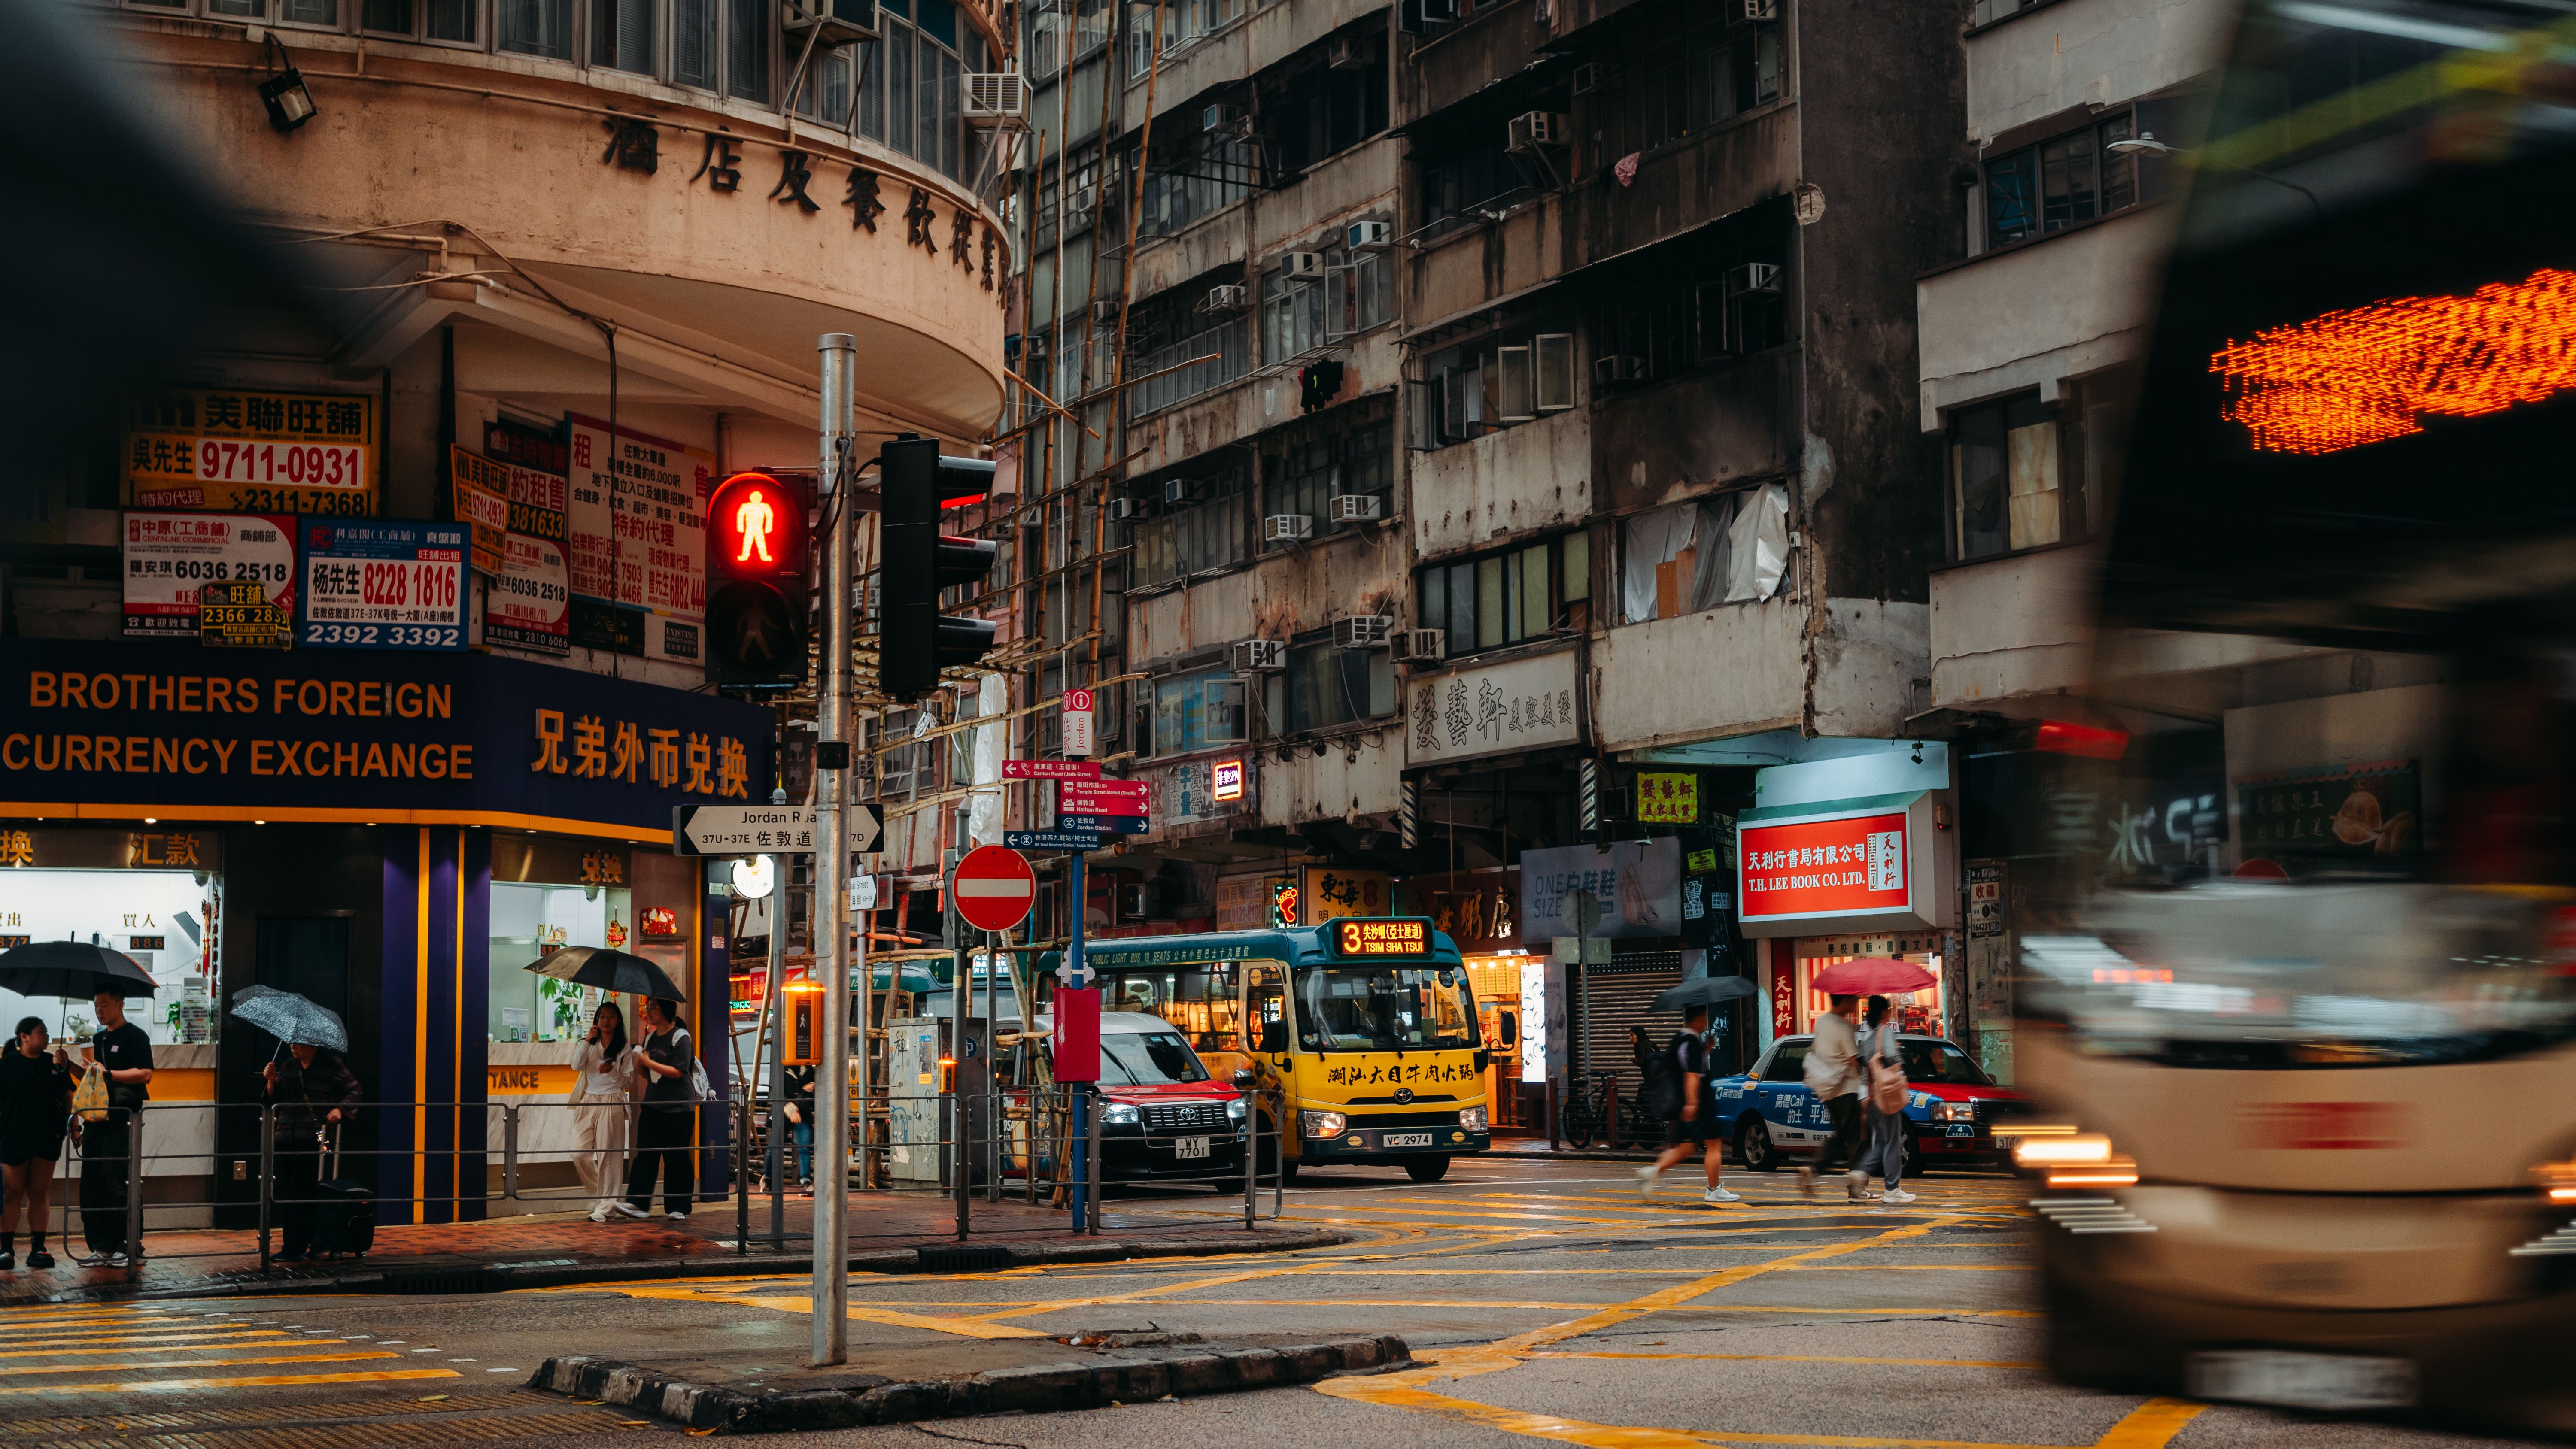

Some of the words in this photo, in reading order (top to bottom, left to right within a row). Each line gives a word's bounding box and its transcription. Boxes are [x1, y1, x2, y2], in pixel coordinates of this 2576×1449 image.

[204, 396, 361, 435] 美聯旺舖
[132, 439, 193, 474] 吳先生
[202, 442, 358, 485] 9711-0931
[574, 433, 591, 469] 租
[472, 458, 507, 497] 美聯旺舖
[694, 464, 708, 499] 售
[141, 490, 204, 507] 特約代理
[244, 489, 365, 516] 2311-7368
[473, 493, 505, 528] 9711-0931
[142, 520, 230, 537] 中原(工商舖)
[240, 530, 276, 542] 商舖部
[182, 536, 230, 544] COMMERCIAL
[335, 528, 416, 542] 利嘉閣(工商舖)
[427, 532, 461, 544] 真盤源
[614, 512, 674, 547] 特約代理
[419, 549, 460, 561] 旺舖出租
[175, 561, 228, 579] 6036
[235, 563, 286, 581] 2518
[597, 558, 618, 579] 9042
[621, 562, 642, 583] 7503
[313, 563, 360, 595] 杨先生
[364, 563, 407, 606] 8228
[414, 564, 455, 607] 1816
[511, 577, 538, 597] 6036
[541, 582, 565, 602] 2518
[597, 578, 618, 599] 9026
[621, 582, 642, 604] 4466
[648, 569, 669, 597] 曾先生
[670, 573, 689, 606] 6882
[205, 609, 245, 622] 2366
[313, 606, 454, 623] 佐敦佐敦道37E-37K号统一大厦(A座)阁楼
[306, 624, 378, 644] 2392
[388, 627, 459, 646] 3392
[526, 632, 545, 644] 2810
[548, 635, 568, 648] 6066
[666, 627, 697, 640] EXISTING
[30, 671, 259, 714] BROTHERS
[273, 679, 452, 719] FOREIGN
[1413, 678, 1507, 751] 髮藝軒
[1509, 689, 1572, 733] 美容美髮
[1064, 717, 1070, 752] 佐敦
[1076, 717, 1086, 750] Jordan
[2, 733, 237, 774] CURRENCY
[251, 740, 473, 780] EXCHANGE
[530, 708, 748, 800] 兄弟外币兑换
[1641, 778, 1694, 800] 髮藝軒
[741, 811, 787, 824] Jordan
[0, 830, 33, 866] 换
[130, 832, 200, 867] 汇款
[702, 835, 723, 844] 37U
[731, 834, 750, 843] 37E
[756, 831, 811, 847] 佐敦道
[580, 851, 622, 883] 兑换
[1748, 843, 1865, 870] 天利行書局有限公司
[1883, 833, 1896, 888] 天利行
[857, 880, 869, 889] Street
[1320, 873, 1360, 908] 東海
[1535, 874, 1564, 895] ONE
[1748, 879, 1767, 892] T.H.
[1769, 876, 1788, 890] LEE
[1790, 874, 1820, 889] BOOK
[1822, 873, 1840, 886] CO.
[1842, 871, 1865, 885] LTD.
[1976, 884, 1995, 899] 收碟
[1534, 897, 1562, 919] SIZE
[131, 937, 163, 949] 886
[1344, 924, 1361, 952] 3
[1363, 923, 1422, 940] 尖沙咀(亞士厘道)
[1092, 955, 1109, 964] PUBLIC
[1112, 952, 1127, 963] LIGHT
[1130, 952, 1140, 962] BUS
[1144, 952, 1150, 962] 19
[1154, 950, 1170, 961] SEATS
[1174, 946, 1249, 961] 公共小型巴士十九座位
[1364, 942, 1384, 952] TSIM
[1386, 942, 1403, 952] SHA
[1404, 942, 1423, 952] TSUI
[1775, 975, 1793, 1029] 天利行
[1327, 1063, 1473, 1086] 潮汕大目牛肉火锅
[1722, 1089, 1744, 1099] 高德地圖
[1775, 1094, 1804, 1109] 高德Call
[1787, 1109, 1802, 1124] 的士
[1185, 1138, 1199, 1148] WY
[1387, 1136, 1399, 1146] VC
[1403, 1135, 1429, 1145] 2974
[1178, 1147, 1205, 1158] 7701
